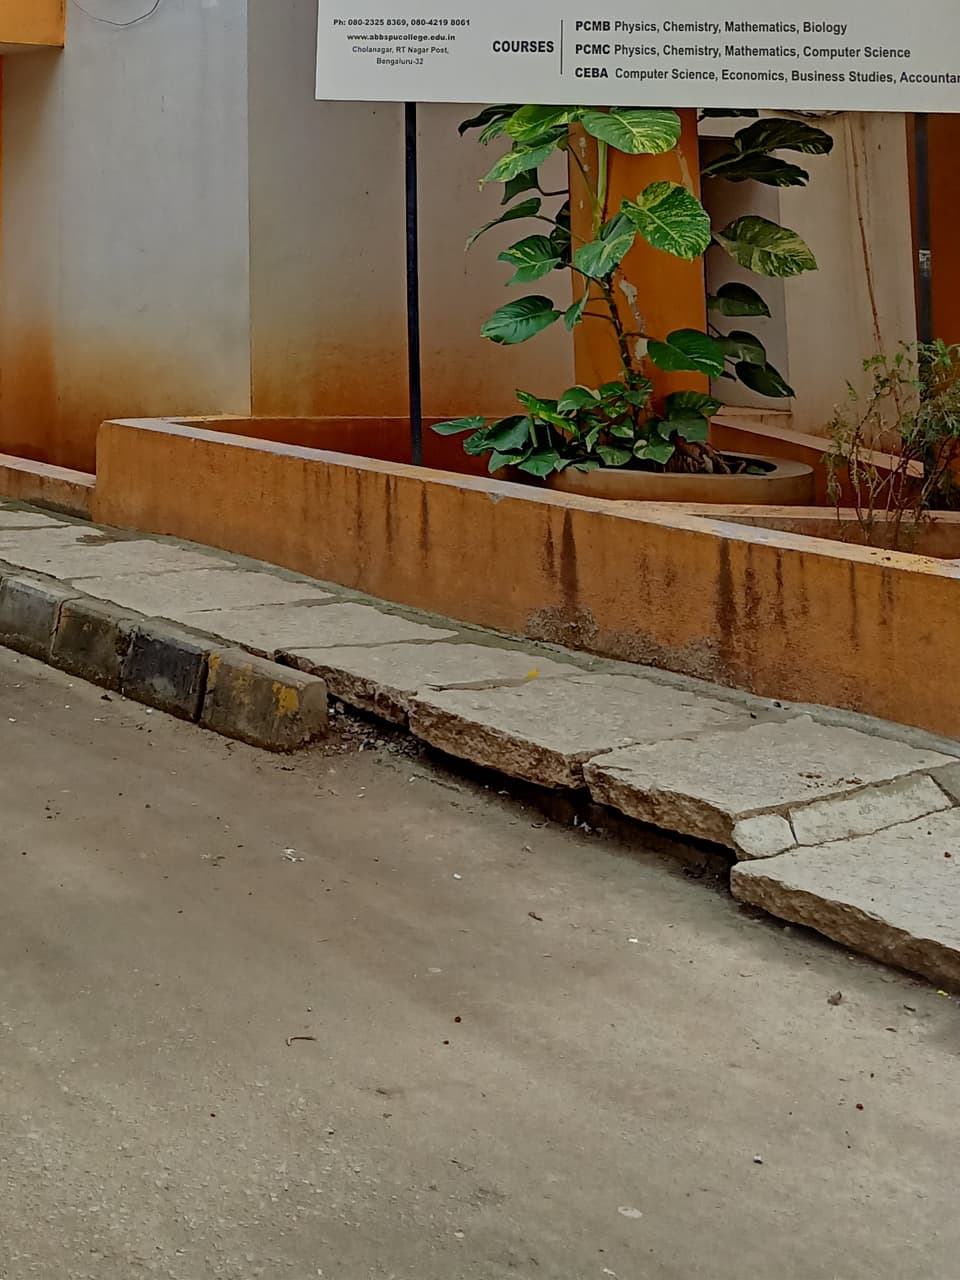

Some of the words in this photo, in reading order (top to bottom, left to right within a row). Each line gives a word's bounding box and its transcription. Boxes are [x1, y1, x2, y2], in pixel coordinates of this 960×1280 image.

[333, 18, 346, 26] Ph:
[348, 18, 385, 26] 080-2325
[411, 18, 448, 26] 080-4219
[450, 18, 471, 26] 8061
[575, 21, 611, 32] PCMB
[614, 21, 660, 34] Physics,
[663, 20, 722, 34] Chemistry,
[724, 21, 800, 34] Mathematics,
[803, 21, 848, 35] Biology
[408, 46, 429, 55] Nagar
[431, 46, 449, 54] Post,
[492, 40, 555, 53] COURSES
[575, 44, 611, 55] PCMC
[614, 44, 660, 58] Physics,
[663, 44, 722, 58] Chemistry,
[724, 45, 800, 58] Mathematics,
[803, 46, 861, 60] Computer
[864, 46, 911, 58] Science
[376, 58, 424, 66] Bengaluru-32
[575, 68, 609, 79] CEBA
[615, 68, 669, 81] Computer
[671, 68, 719, 82] Science,
[721, 69, 789, 83] Economics,
[791, 71, 845, 82] Business
[848, 71, 897, 84] Studies,
